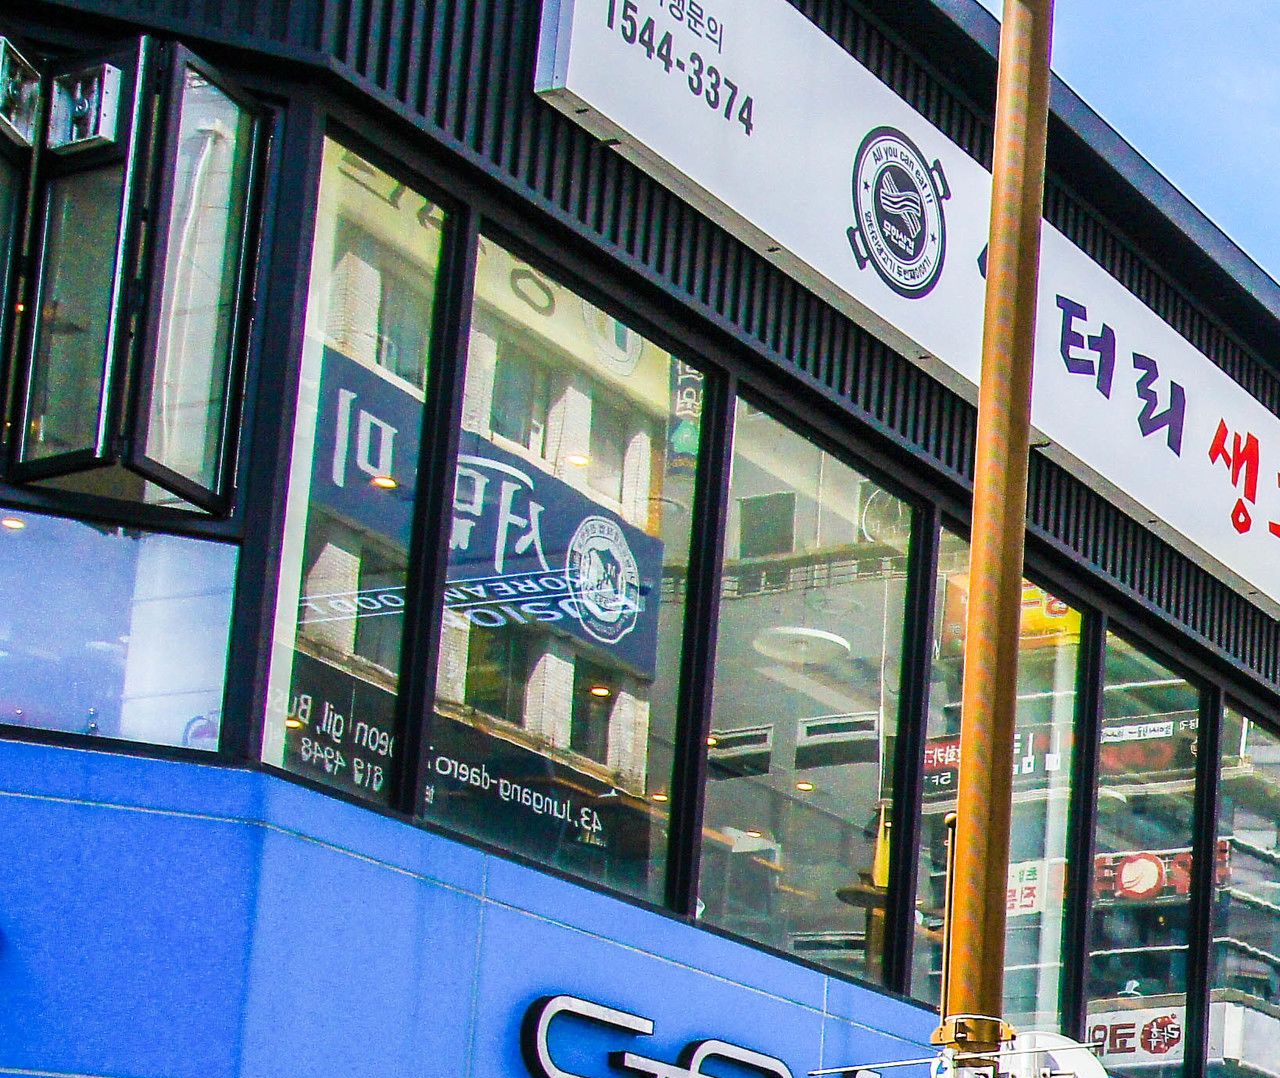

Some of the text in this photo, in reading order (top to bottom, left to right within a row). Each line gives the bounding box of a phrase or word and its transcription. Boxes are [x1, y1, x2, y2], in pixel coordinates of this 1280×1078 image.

[660, 0, 723, 54] 문의
[607, 0, 753, 137] 1544-3374
[872, 146, 928, 188] All you can eat
